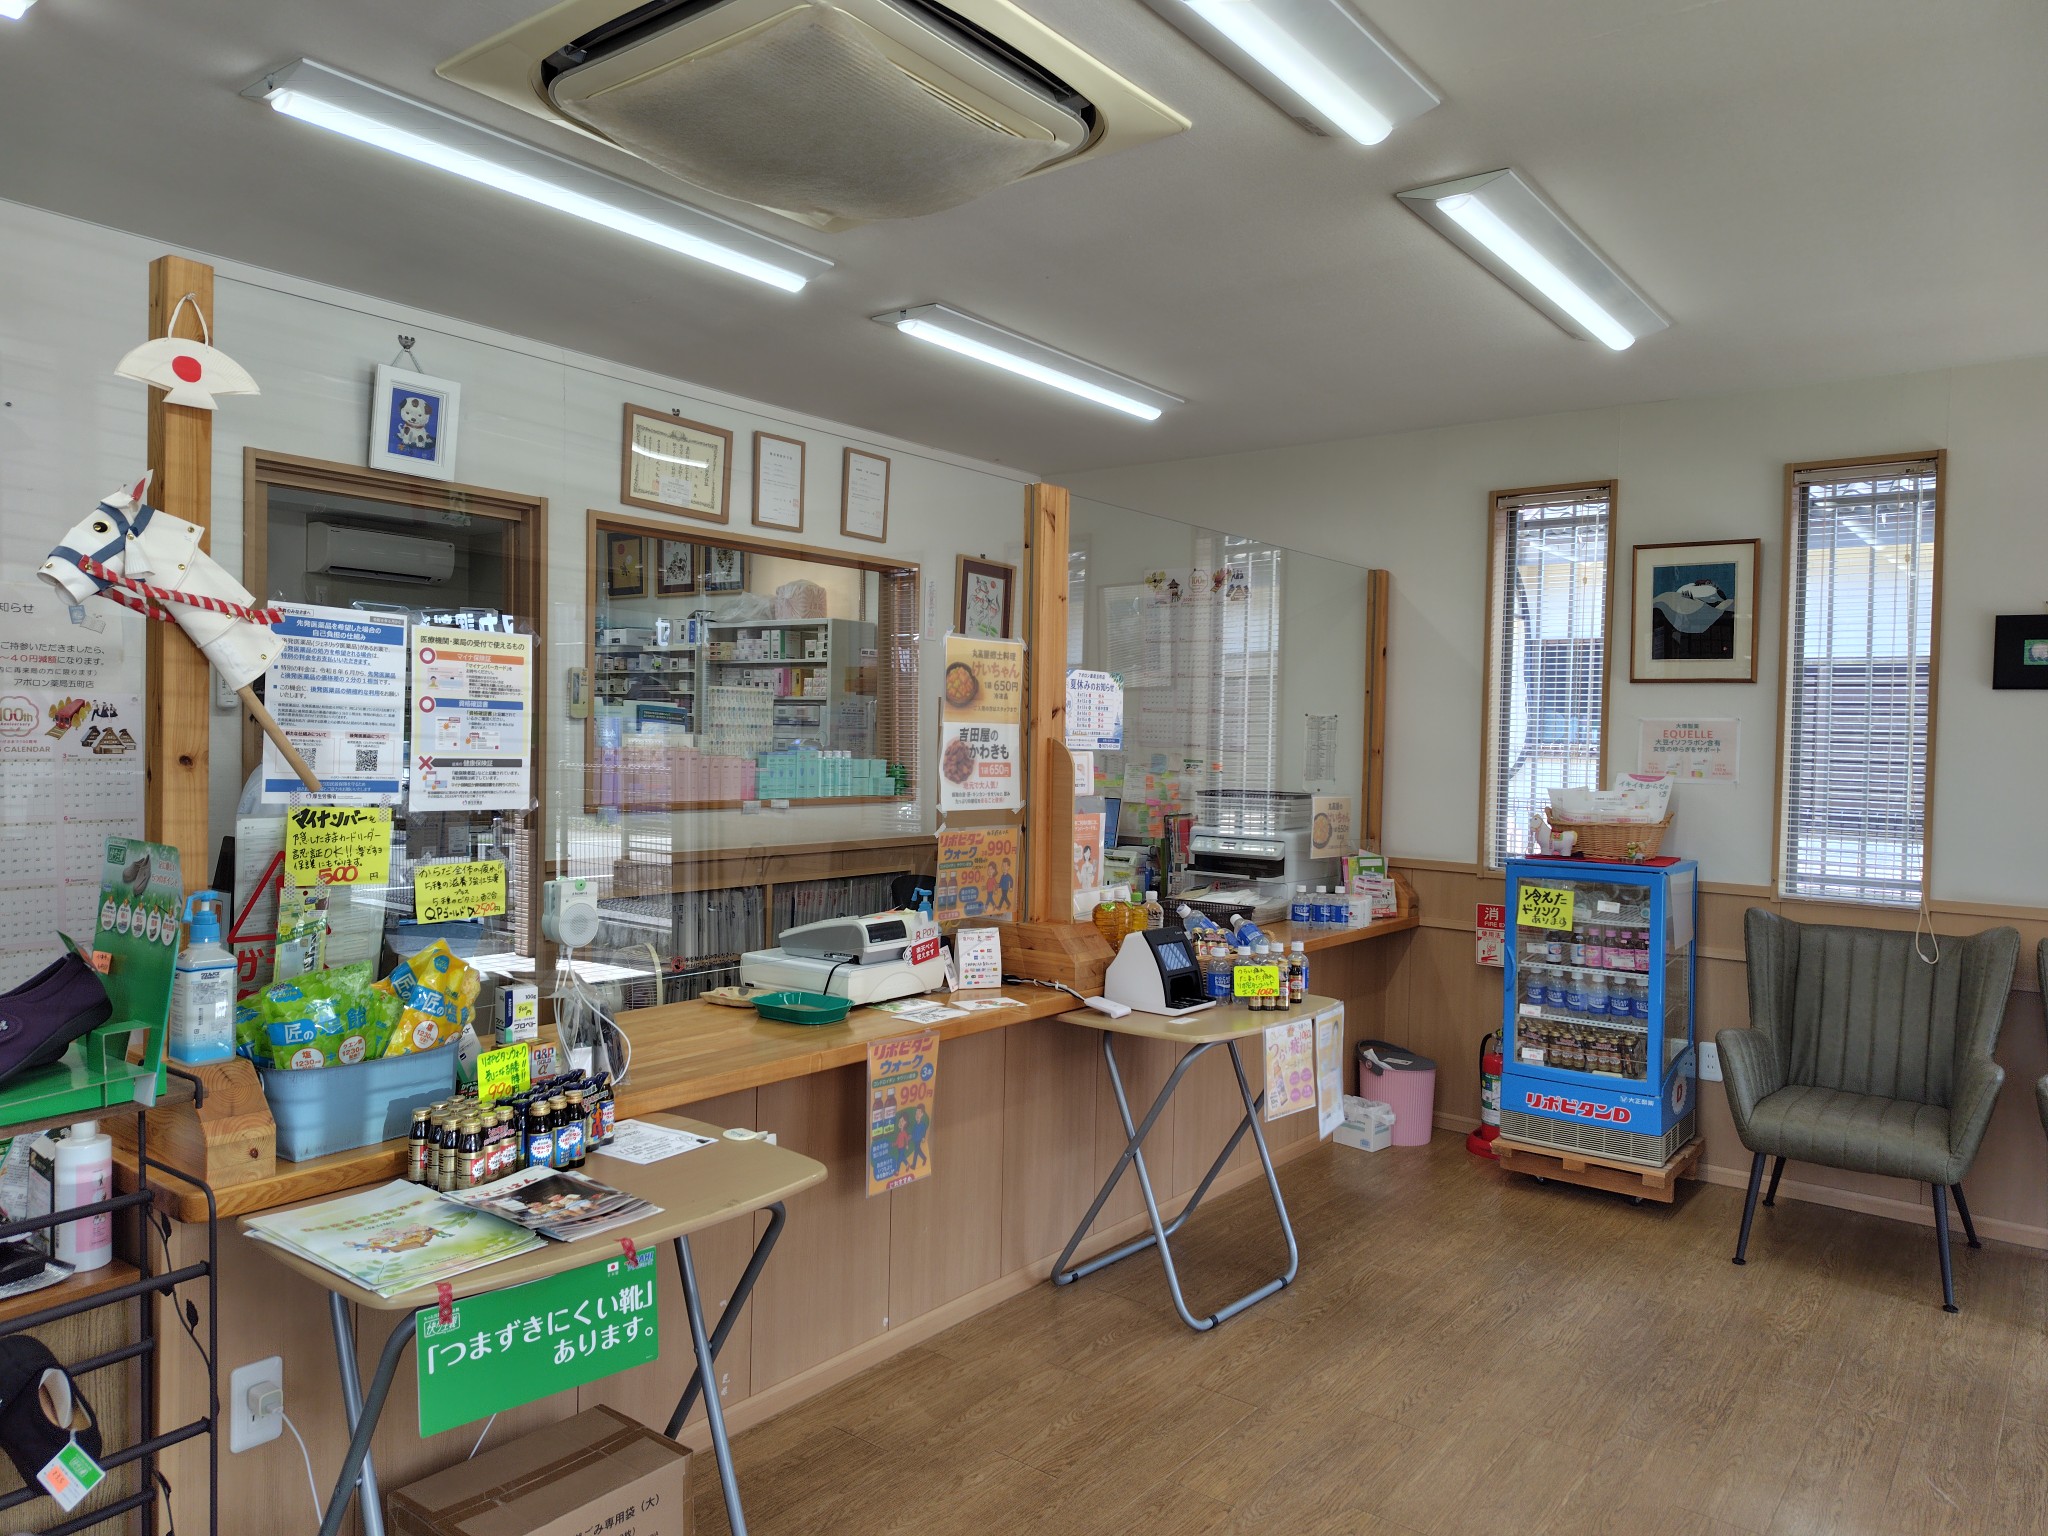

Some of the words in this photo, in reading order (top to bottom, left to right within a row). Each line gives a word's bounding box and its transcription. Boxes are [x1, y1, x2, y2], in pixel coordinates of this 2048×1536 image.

[296, 619, 381, 634] 先発医薬品を希望した場合の
[312, 630, 366, 641] 自己負担の仕組み
[420, 635, 525, 651] 医療機関・薬局の受付で使えるもの
[1, 641, 105, 654] ご持参いただきましたら、
[971, 661, 1020, 679] けいちゃん
[1070, 679, 1115, 692] 夏休みのお知らせ
[959, 727, 998, 742] 吉田屋の
[1663, 730, 1713, 739] EQUELLE
[1655, 739, 1721, 747] 大豆イソフラボン含有
[969, 743, 1009, 760] かわきも
[319, 866, 359, 885] 500
[1525, 888, 1567, 905] 冷えた
[1484, 907, 1499, 921] 消
[1522, 904, 1560, 918] ドリンク
[1532, 915, 1567, 928] あります
[285, 1022, 315, 1044] 匠の
[514, 1021, 536, 1029] プロペト
[534, 1047, 553, 1061] Q&P
[874, 1037, 934, 1060] リポビタン
[879, 1054, 924, 1075] ウォーク
[901, 1081, 933, 1106] 990円
[1677, 1084, 1682, 1103] D
[1526, 1092, 1631, 1123] リポビタンD
[428, 1280, 654, 1375] 「つまずきにくい靴」
[554, 1316, 654, 1365] あります。
